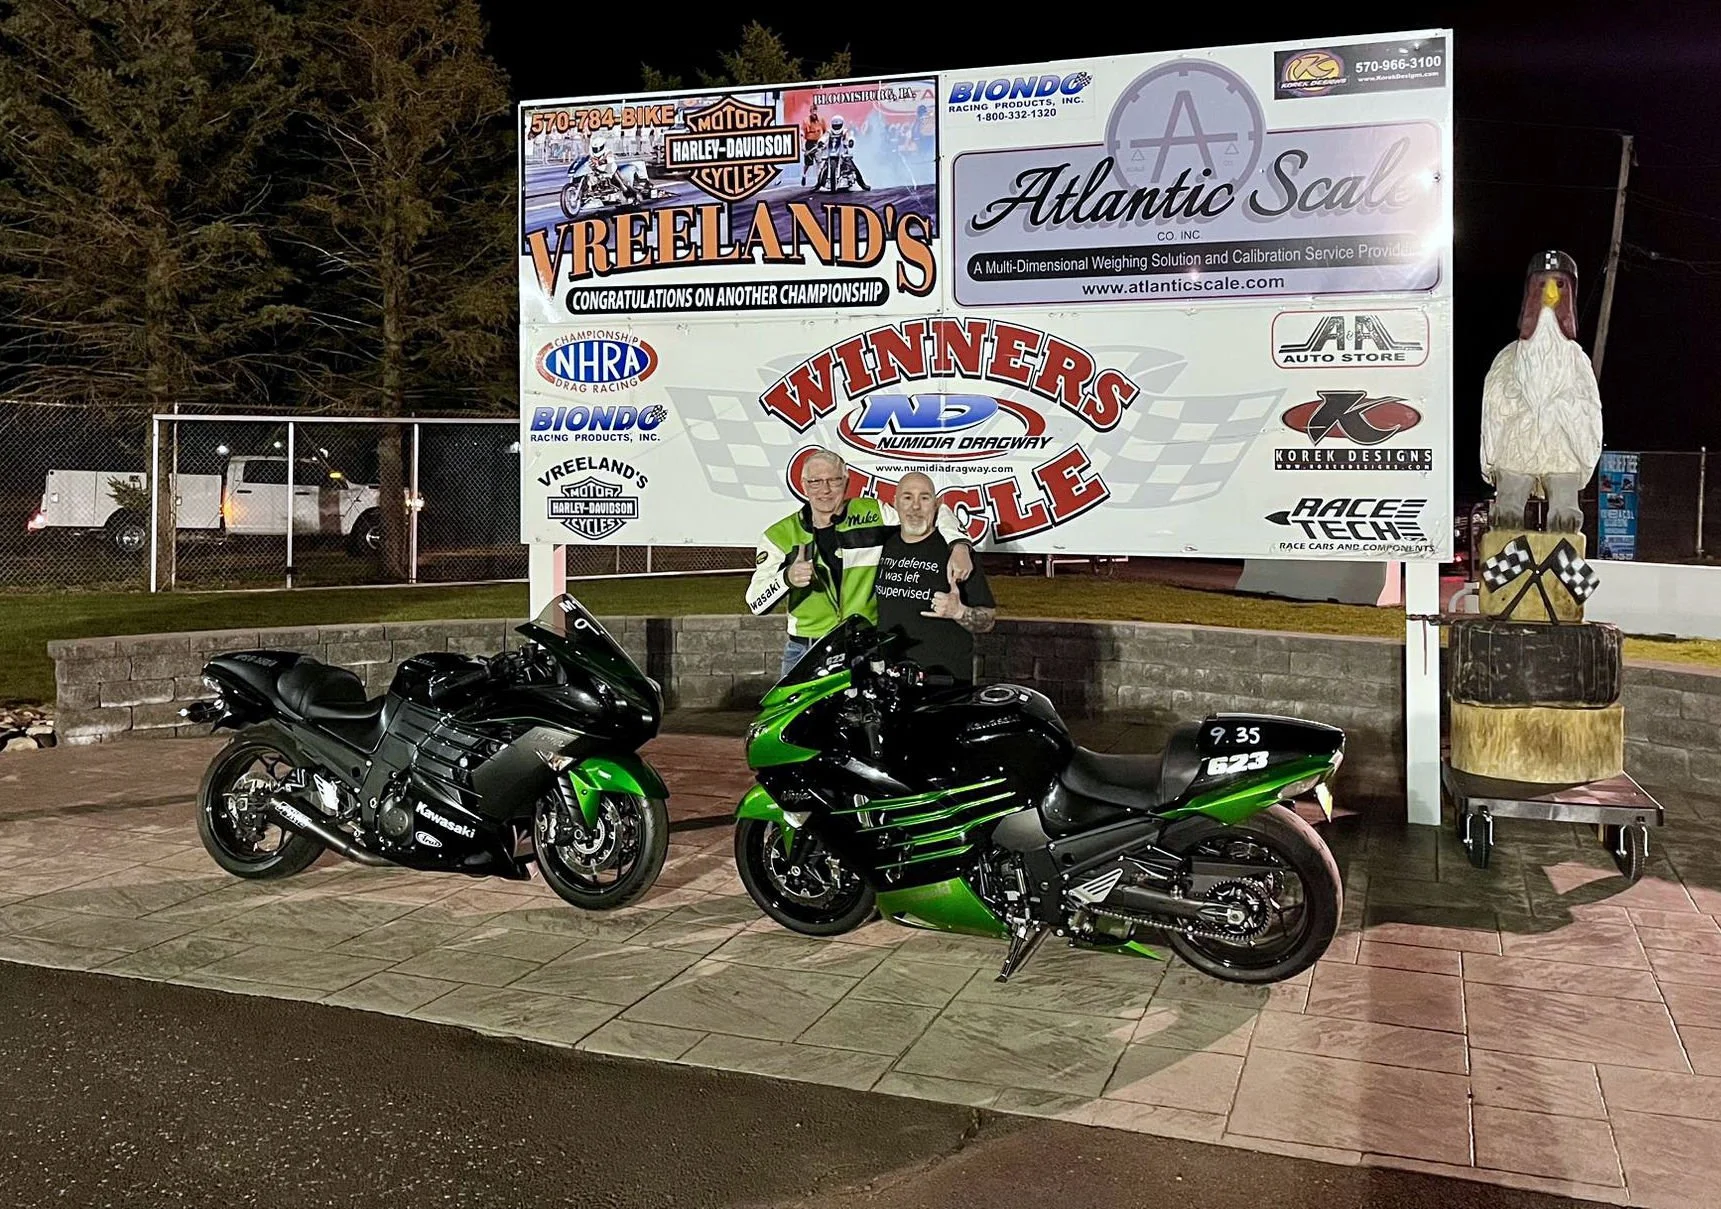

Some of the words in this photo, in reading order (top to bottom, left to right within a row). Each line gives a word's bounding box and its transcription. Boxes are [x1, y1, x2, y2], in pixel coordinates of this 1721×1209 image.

[1355, 56, 1442, 73] 570-966-3100
[948, 72, 1089, 104] BIONDO
[1281, 81, 1309, 89] KOREK
[813, 89, 898, 105] BLOOMSBURG,
[948, 104, 989, 113] RACING
[995, 99, 1056, 110] PRODUCTS,
[1062, 97, 1084, 105] INC.
[531, 104, 675, 134] 570-784-BIKE
[698, 105, 762, 132] MOTOR
[976, 108, 1057, 122] 1-800-332-1320
[672, 134, 792, 161] HARLEY-DAVIDSON
[701, 165, 766, 194] CYCLES
[970, 157, 1235, 231] Atlantic
[1248, 137, 1412, 218] Scale
[525, 200, 937, 300] VREELAND'S
[973, 263, 982, 274] A
[985, 256, 1088, 274] Multi-Dimensional
[1092, 254, 1148, 271] Weighing
[1151, 251, 1201, 266] Solution
[1205, 249, 1229, 265] and
[1232, 247, 1300, 264] Calibration
[1305, 245, 1354, 261] Service
[1082, 276, 1285, 295] www.atlanticscale.com
[572, 287, 693, 311] CONGRATULATIONS
[696, 290, 715, 307] ON
[716, 286, 777, 307] ANOTHER
[780, 281, 883, 305] CHAMPIONSHIP
[554, 330, 639, 347] CHAMPIONSHIP
[555, 341, 641, 382] NHRA
[1283, 354, 1335, 363] AUTO
[1341, 352, 1406, 362] STORE
[759, 317, 1140, 433] WINNERS
[555, 378, 587, 393] DRAG
[593, 377, 638, 393] RACING
[530, 405, 664, 431] BIONDO
[575, 433, 633, 443] PRODUCTS,
[639, 433, 660, 441] INC.
[877, 437, 950, 450] NUMIDIA
[958, 436, 1054, 450] DRAGWAY
[1276, 450, 1335, 461] KOREK
[1349, 450, 1432, 461] DESIGNS
[537, 456, 648, 489] VREELAND'S
[876, 463, 1014, 475] www.numidiadragway.com
[570, 482, 614, 497] MOTOR
[552, 502, 633, 514] HARLEY-DAVIDSON
[1291, 498, 1402, 517] RACE
[571, 518, 616, 535] CYCLES
[847, 510, 880, 527] Mike
[1291, 520, 1401, 540] TECH
[1279, 542, 1306, 550] RACE
[1308, 542, 1334, 550] CARS
[1362, 544, 1435, 552] COMPONENTS
[884, 557, 898, 570] my
[898, 557, 940, 573] defense,
[885, 571, 902, 582] was
[904, 571, 920, 583] left
[750, 578, 781, 610] wasaki
[1207, 751, 1269, 776] 623
[415, 801, 476, 839] Kawasaki
